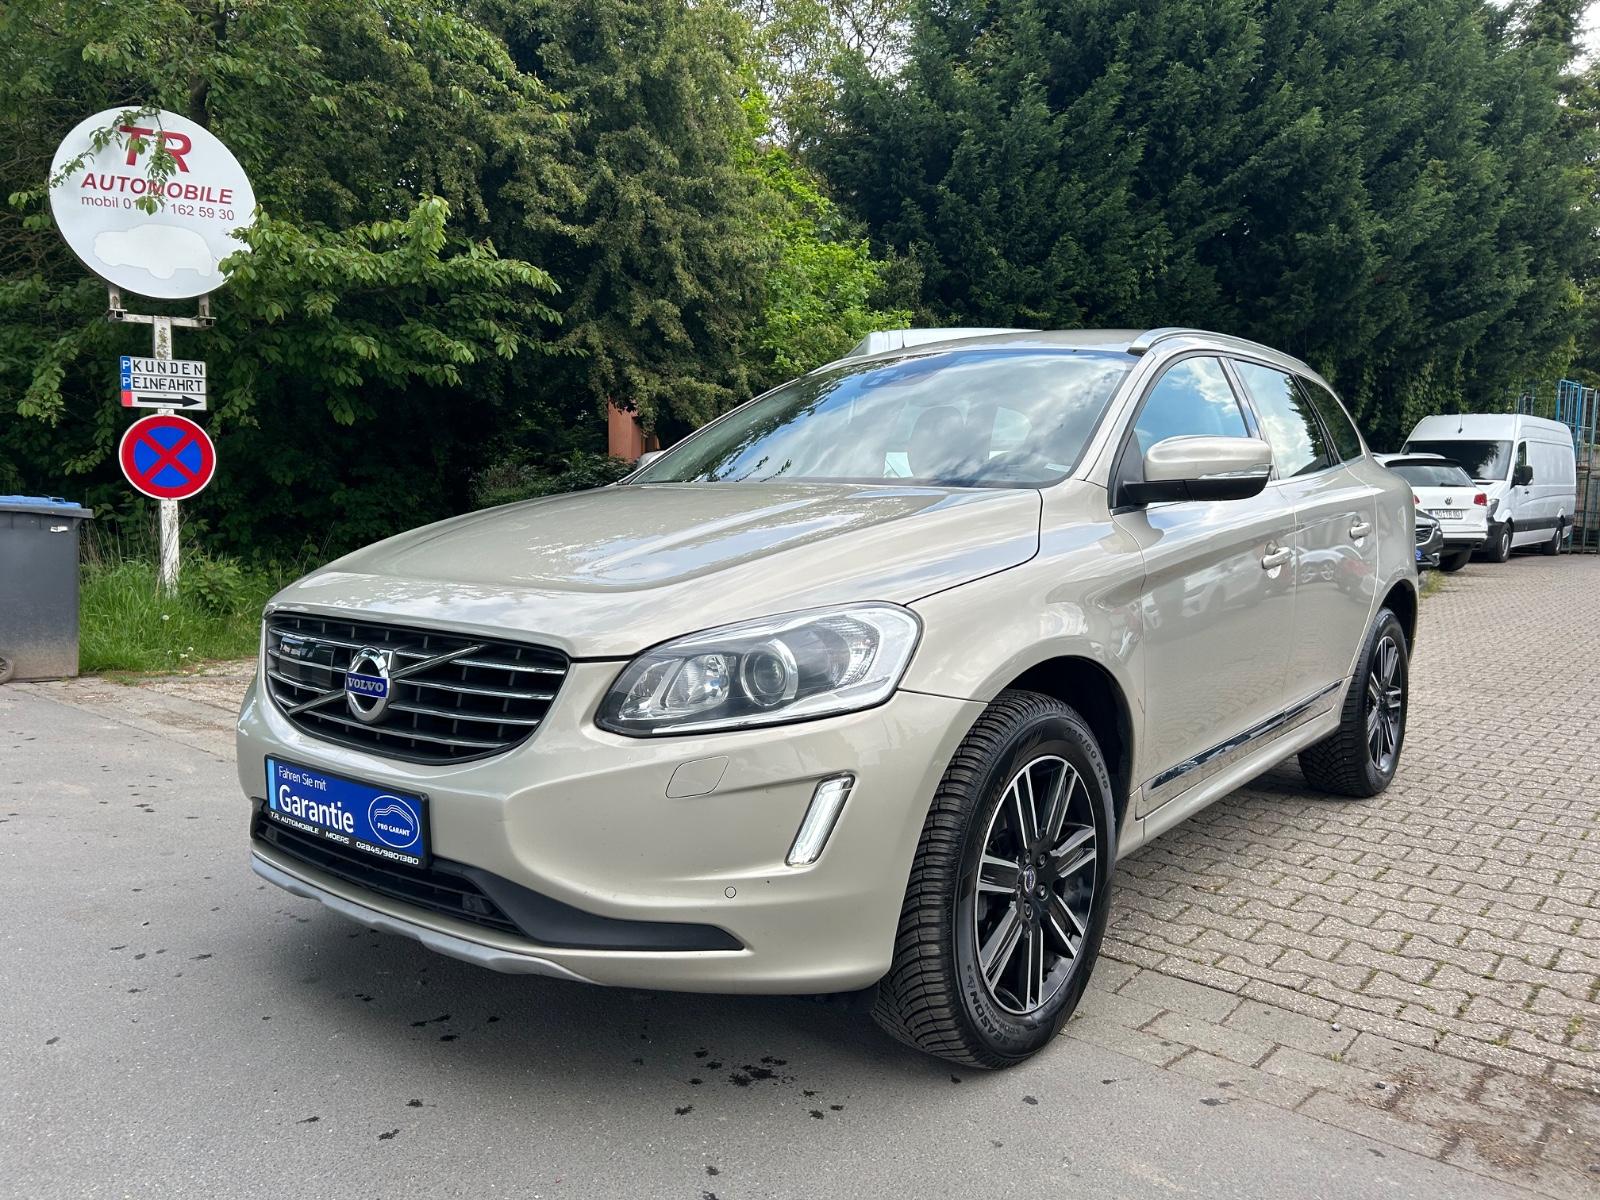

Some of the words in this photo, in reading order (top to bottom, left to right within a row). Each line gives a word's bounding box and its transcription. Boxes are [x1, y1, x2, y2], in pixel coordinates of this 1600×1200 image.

[119, 125, 191, 173] TR
[81, 173, 233, 204] AUTOMOBILE
[81, 194, 119, 209] mobil
[170, 203, 194, 217] 162
[199, 206, 215, 219] 59
[219, 208, 235, 221] 30
[122, 360, 131, 370] P
[133, 360, 203, 375] KUNDEN
[122, 376, 131, 387] P
[132, 376, 203, 392] EINFAHRT
[347, 677, 384, 693] VOLVO
[278, 765, 301, 784] Fahren
[302, 773, 314, 787] Sie
[314, 778, 327, 792] mit
[279, 784, 355, 834] Garantie
[280, 816, 320, 835] AUTOMOBILE
[325, 831, 350, 845] MOERS
[377, 822, 388, 831] PRO
[388, 825, 411, 837] GARANT
